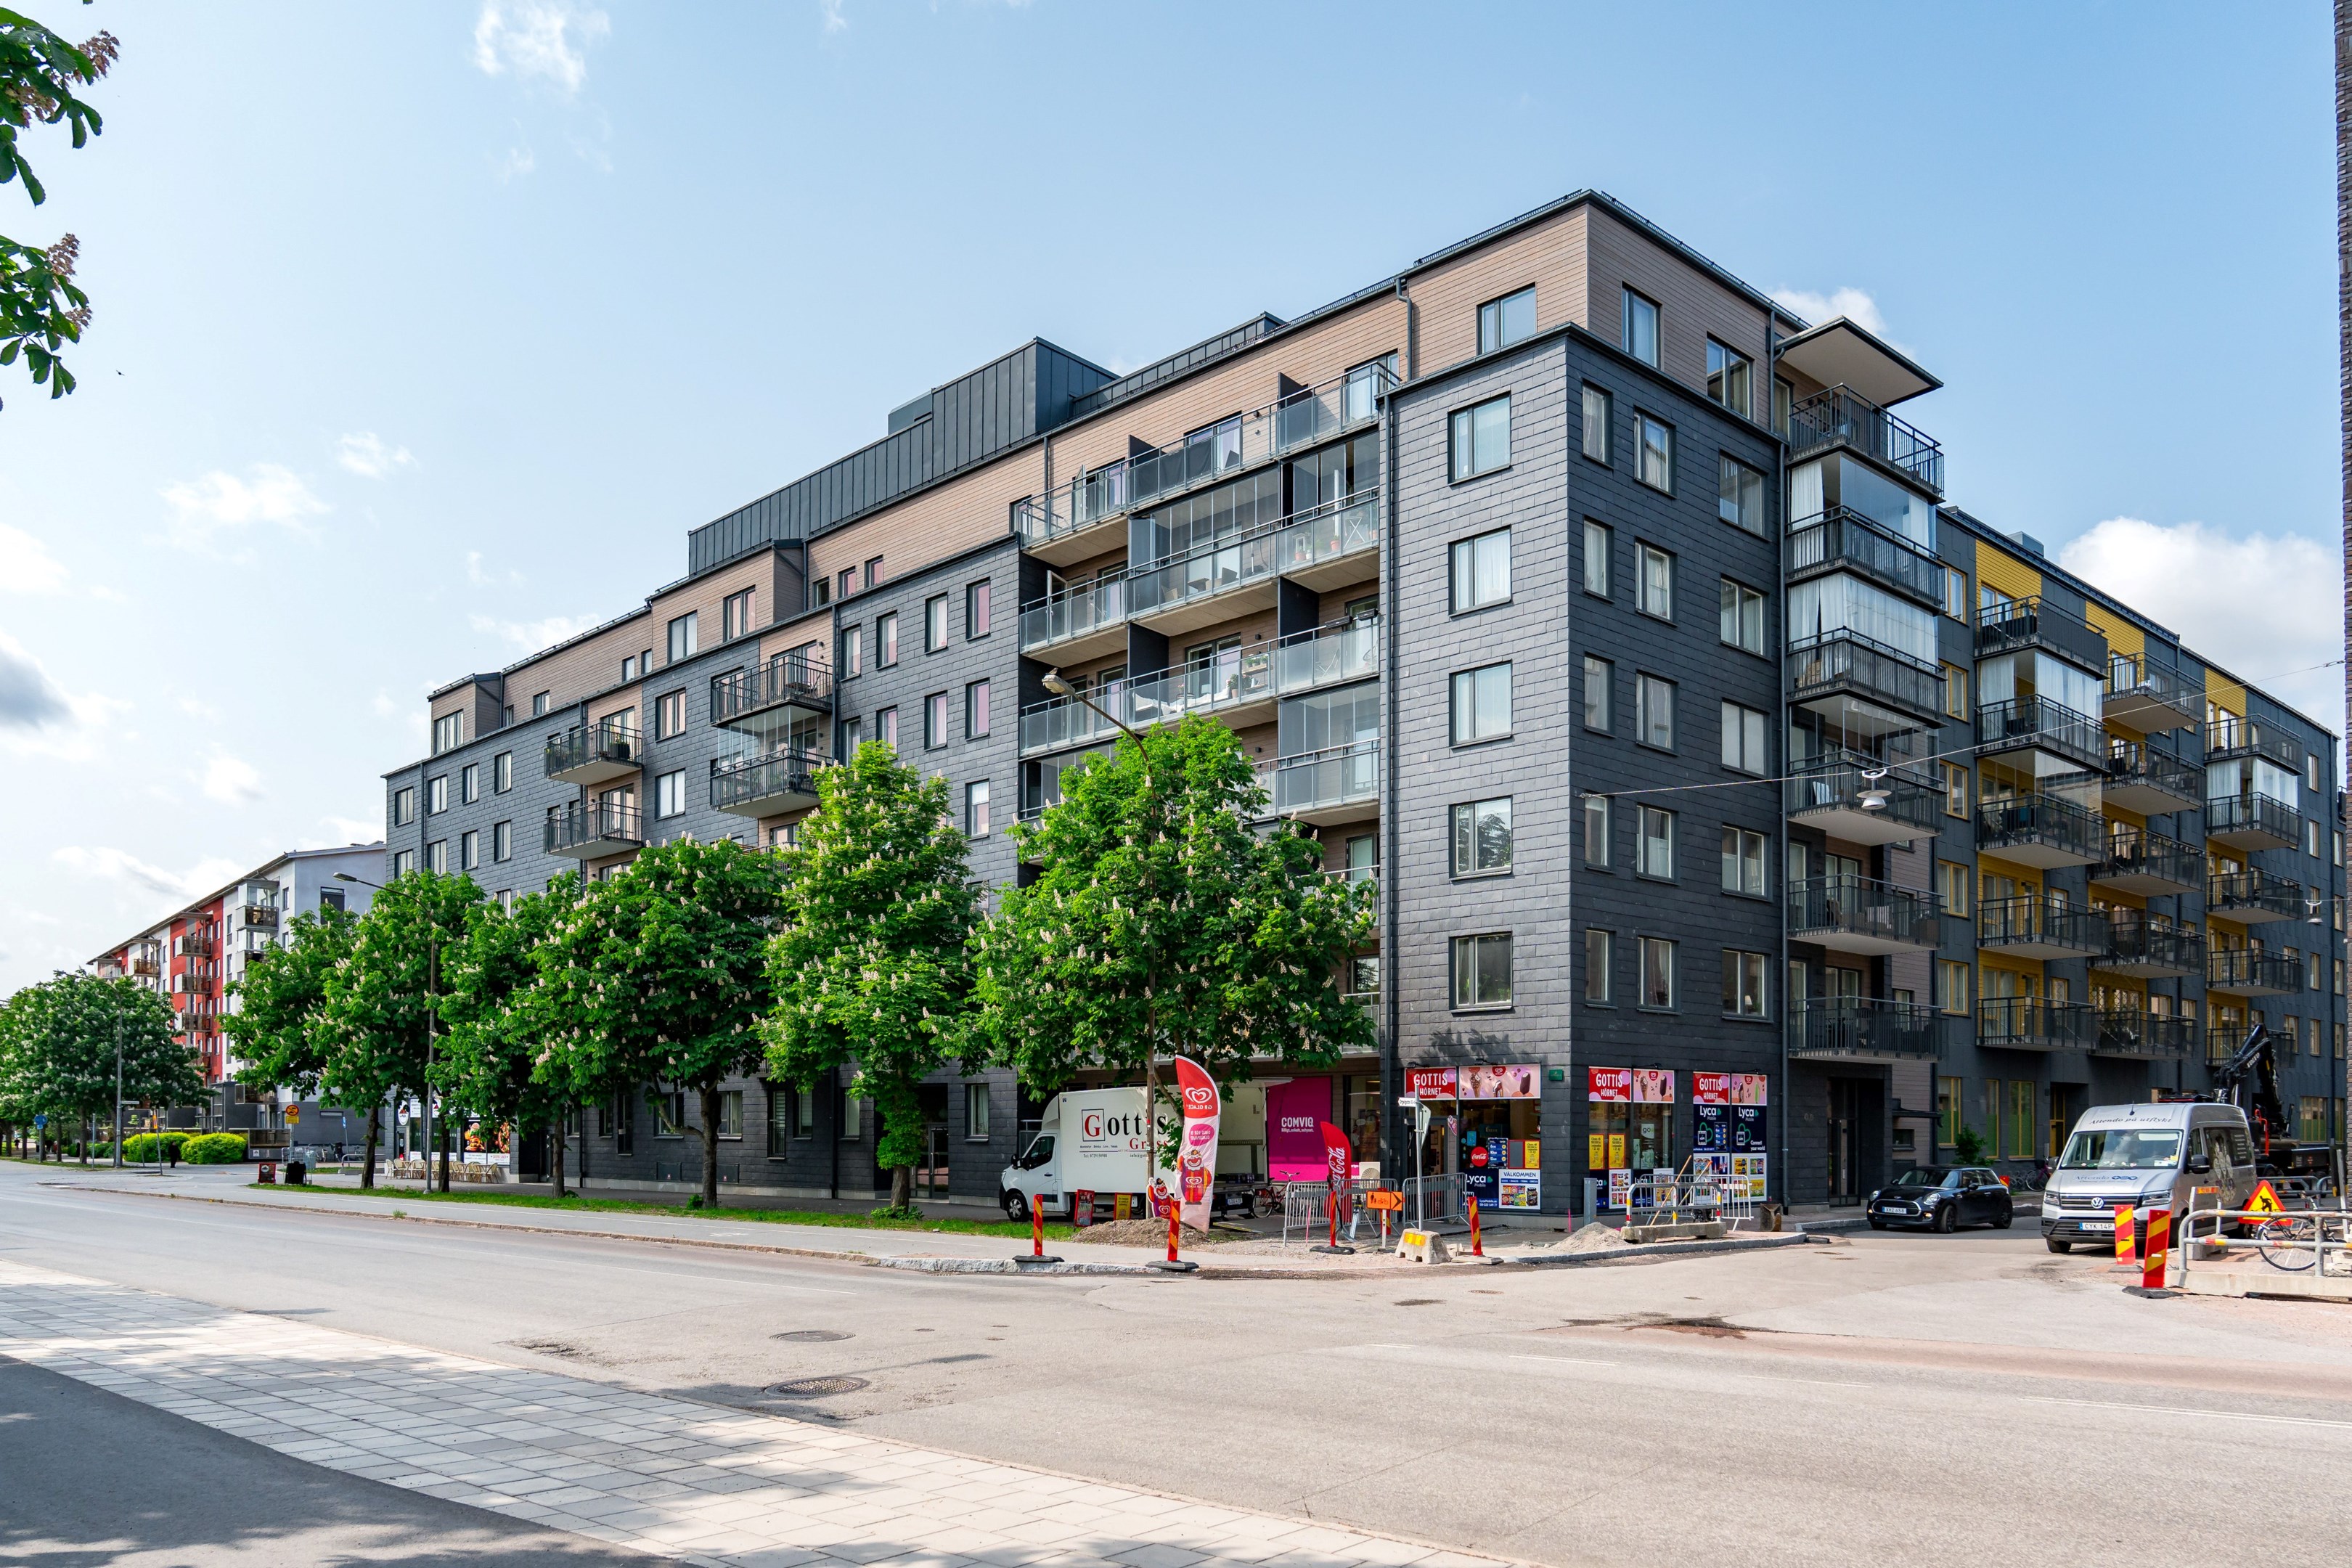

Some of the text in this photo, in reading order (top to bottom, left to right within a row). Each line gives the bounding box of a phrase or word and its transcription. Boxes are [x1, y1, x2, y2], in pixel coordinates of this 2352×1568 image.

[1413, 1074, 1447, 1085] GOTTIS
[1596, 1074, 1622, 1087] GOTTIS
[1699, 1078, 1723, 1091] GOTTIS
[1601, 1088, 1618, 1097] HÖRNET
[1699, 1106, 1717, 1117] Lyca
[1739, 1107, 1755, 1118] Lyca
[1085, 1113, 1167, 1137] Gotts
[1281, 1117, 1313, 1127] COMVIQ
[1466, 1174, 1486, 1184] Lyca
